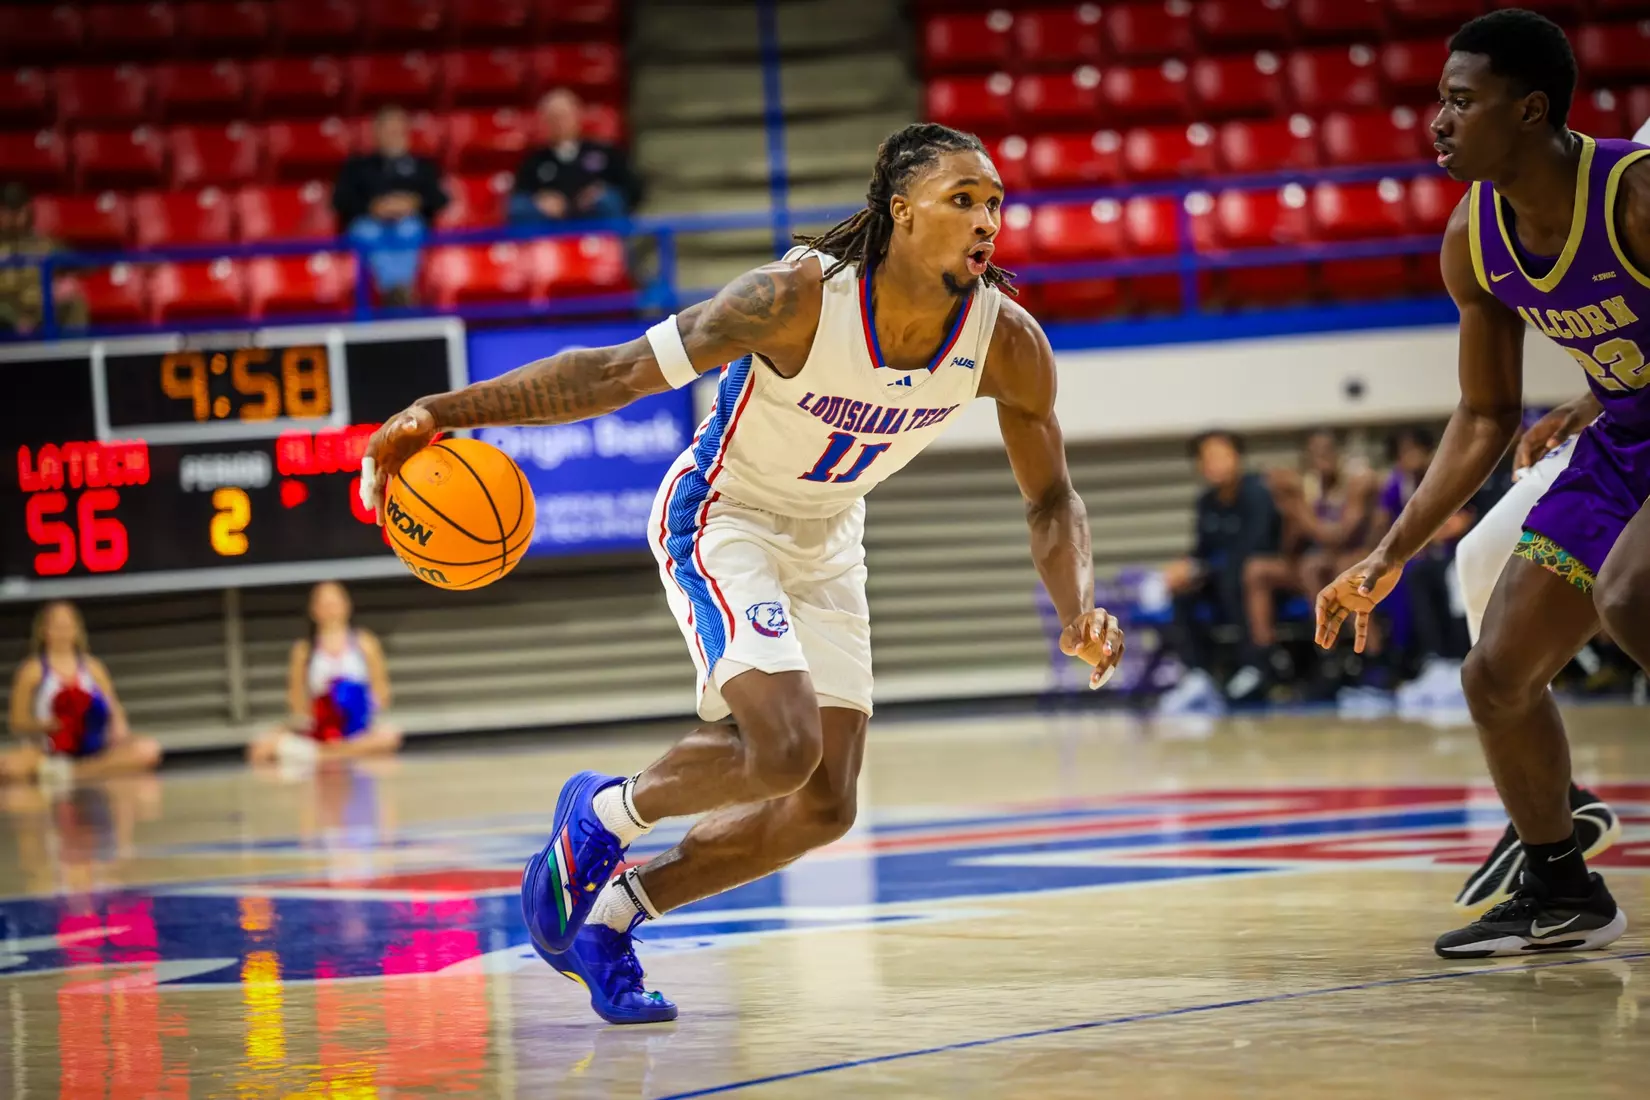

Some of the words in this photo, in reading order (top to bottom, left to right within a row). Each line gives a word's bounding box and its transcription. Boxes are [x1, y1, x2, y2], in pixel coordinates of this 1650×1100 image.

[162, 348, 331, 422] 9:58
[797, 392, 909, 435] LOUISIANA
[797, 431, 892, 483] 11
[25, 488, 129, 575] 56
[210, 486, 251, 556] 2
[387, 494, 433, 547] NCAA
